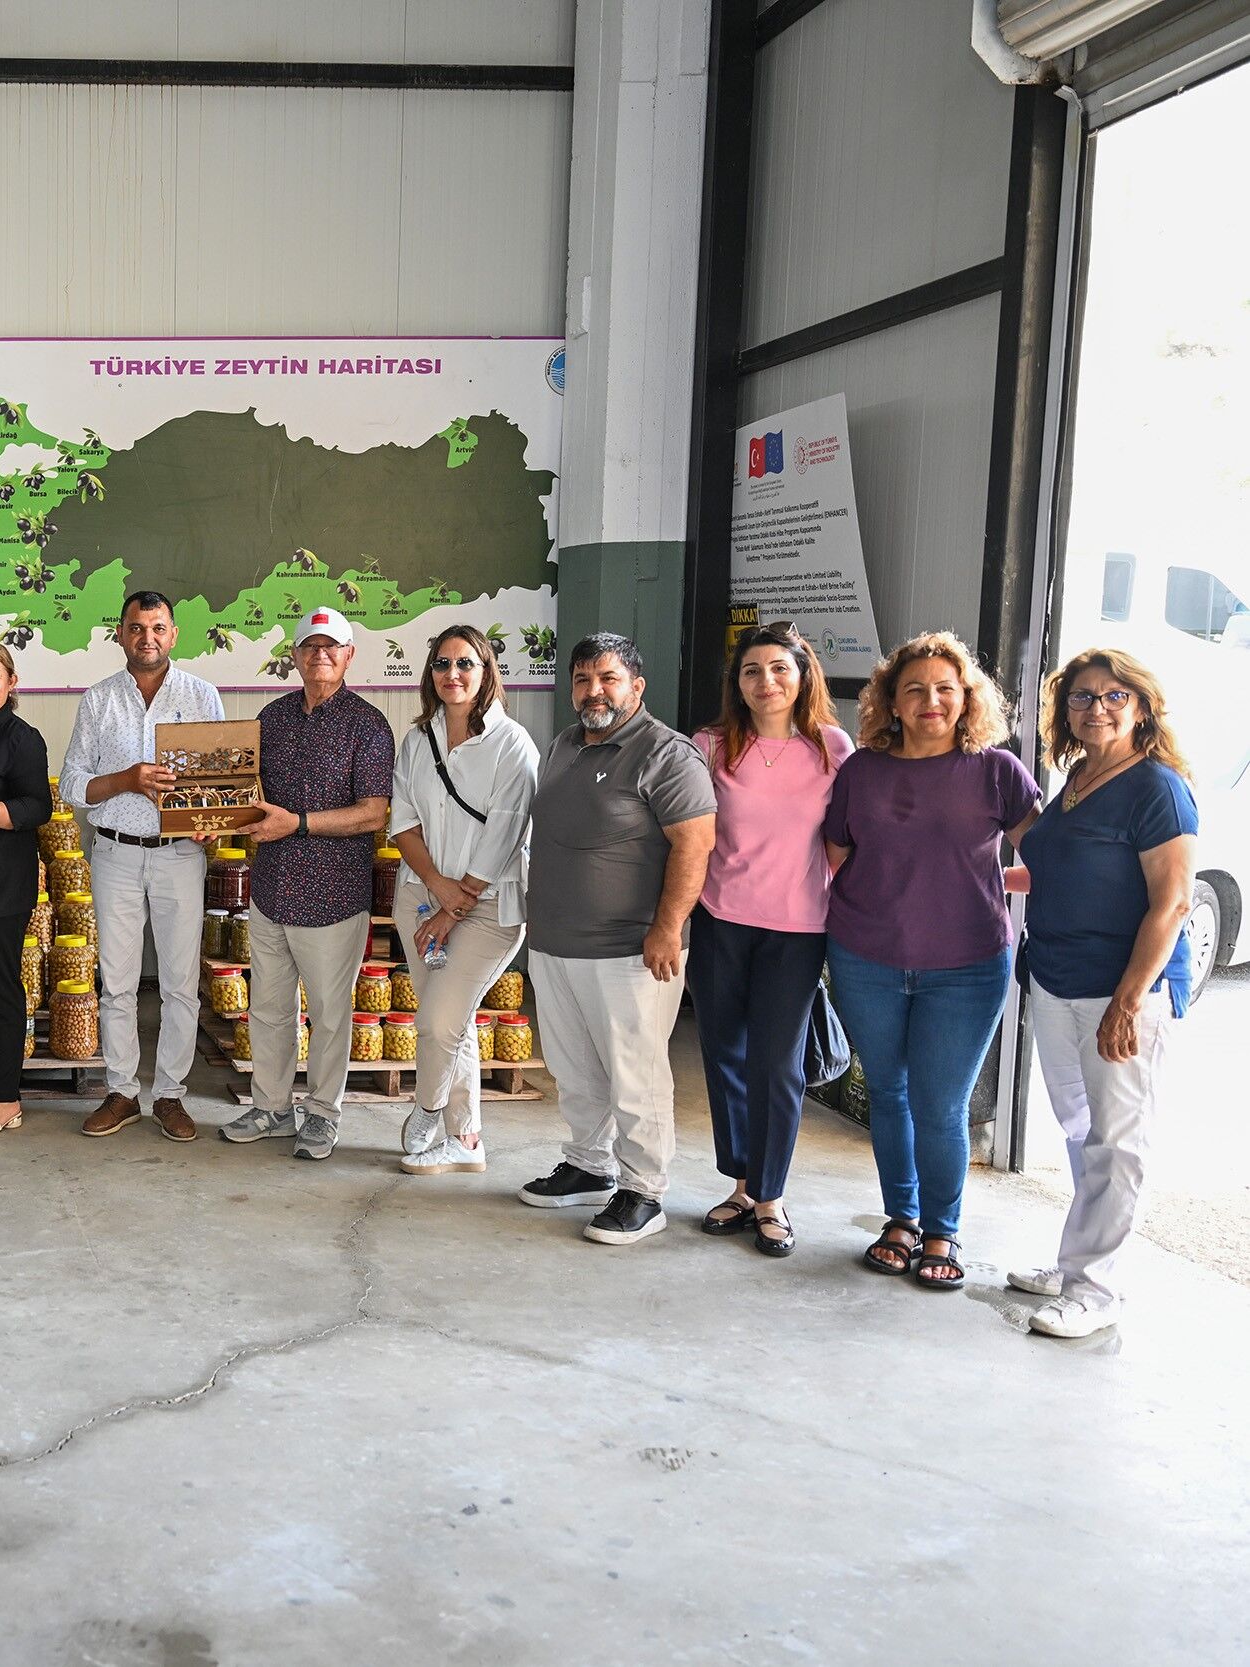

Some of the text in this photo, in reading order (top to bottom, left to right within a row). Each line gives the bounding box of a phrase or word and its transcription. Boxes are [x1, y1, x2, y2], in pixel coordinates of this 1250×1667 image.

[90, 355, 442, 376] TÜRKİYE ZEYTİN HARİTASI
[78, 448, 105, 456] Sakarya
[337, 609, 367, 617] aziantep
[731, 606, 758, 622] DİKKAT
[102, 616, 122, 624] Antaly
